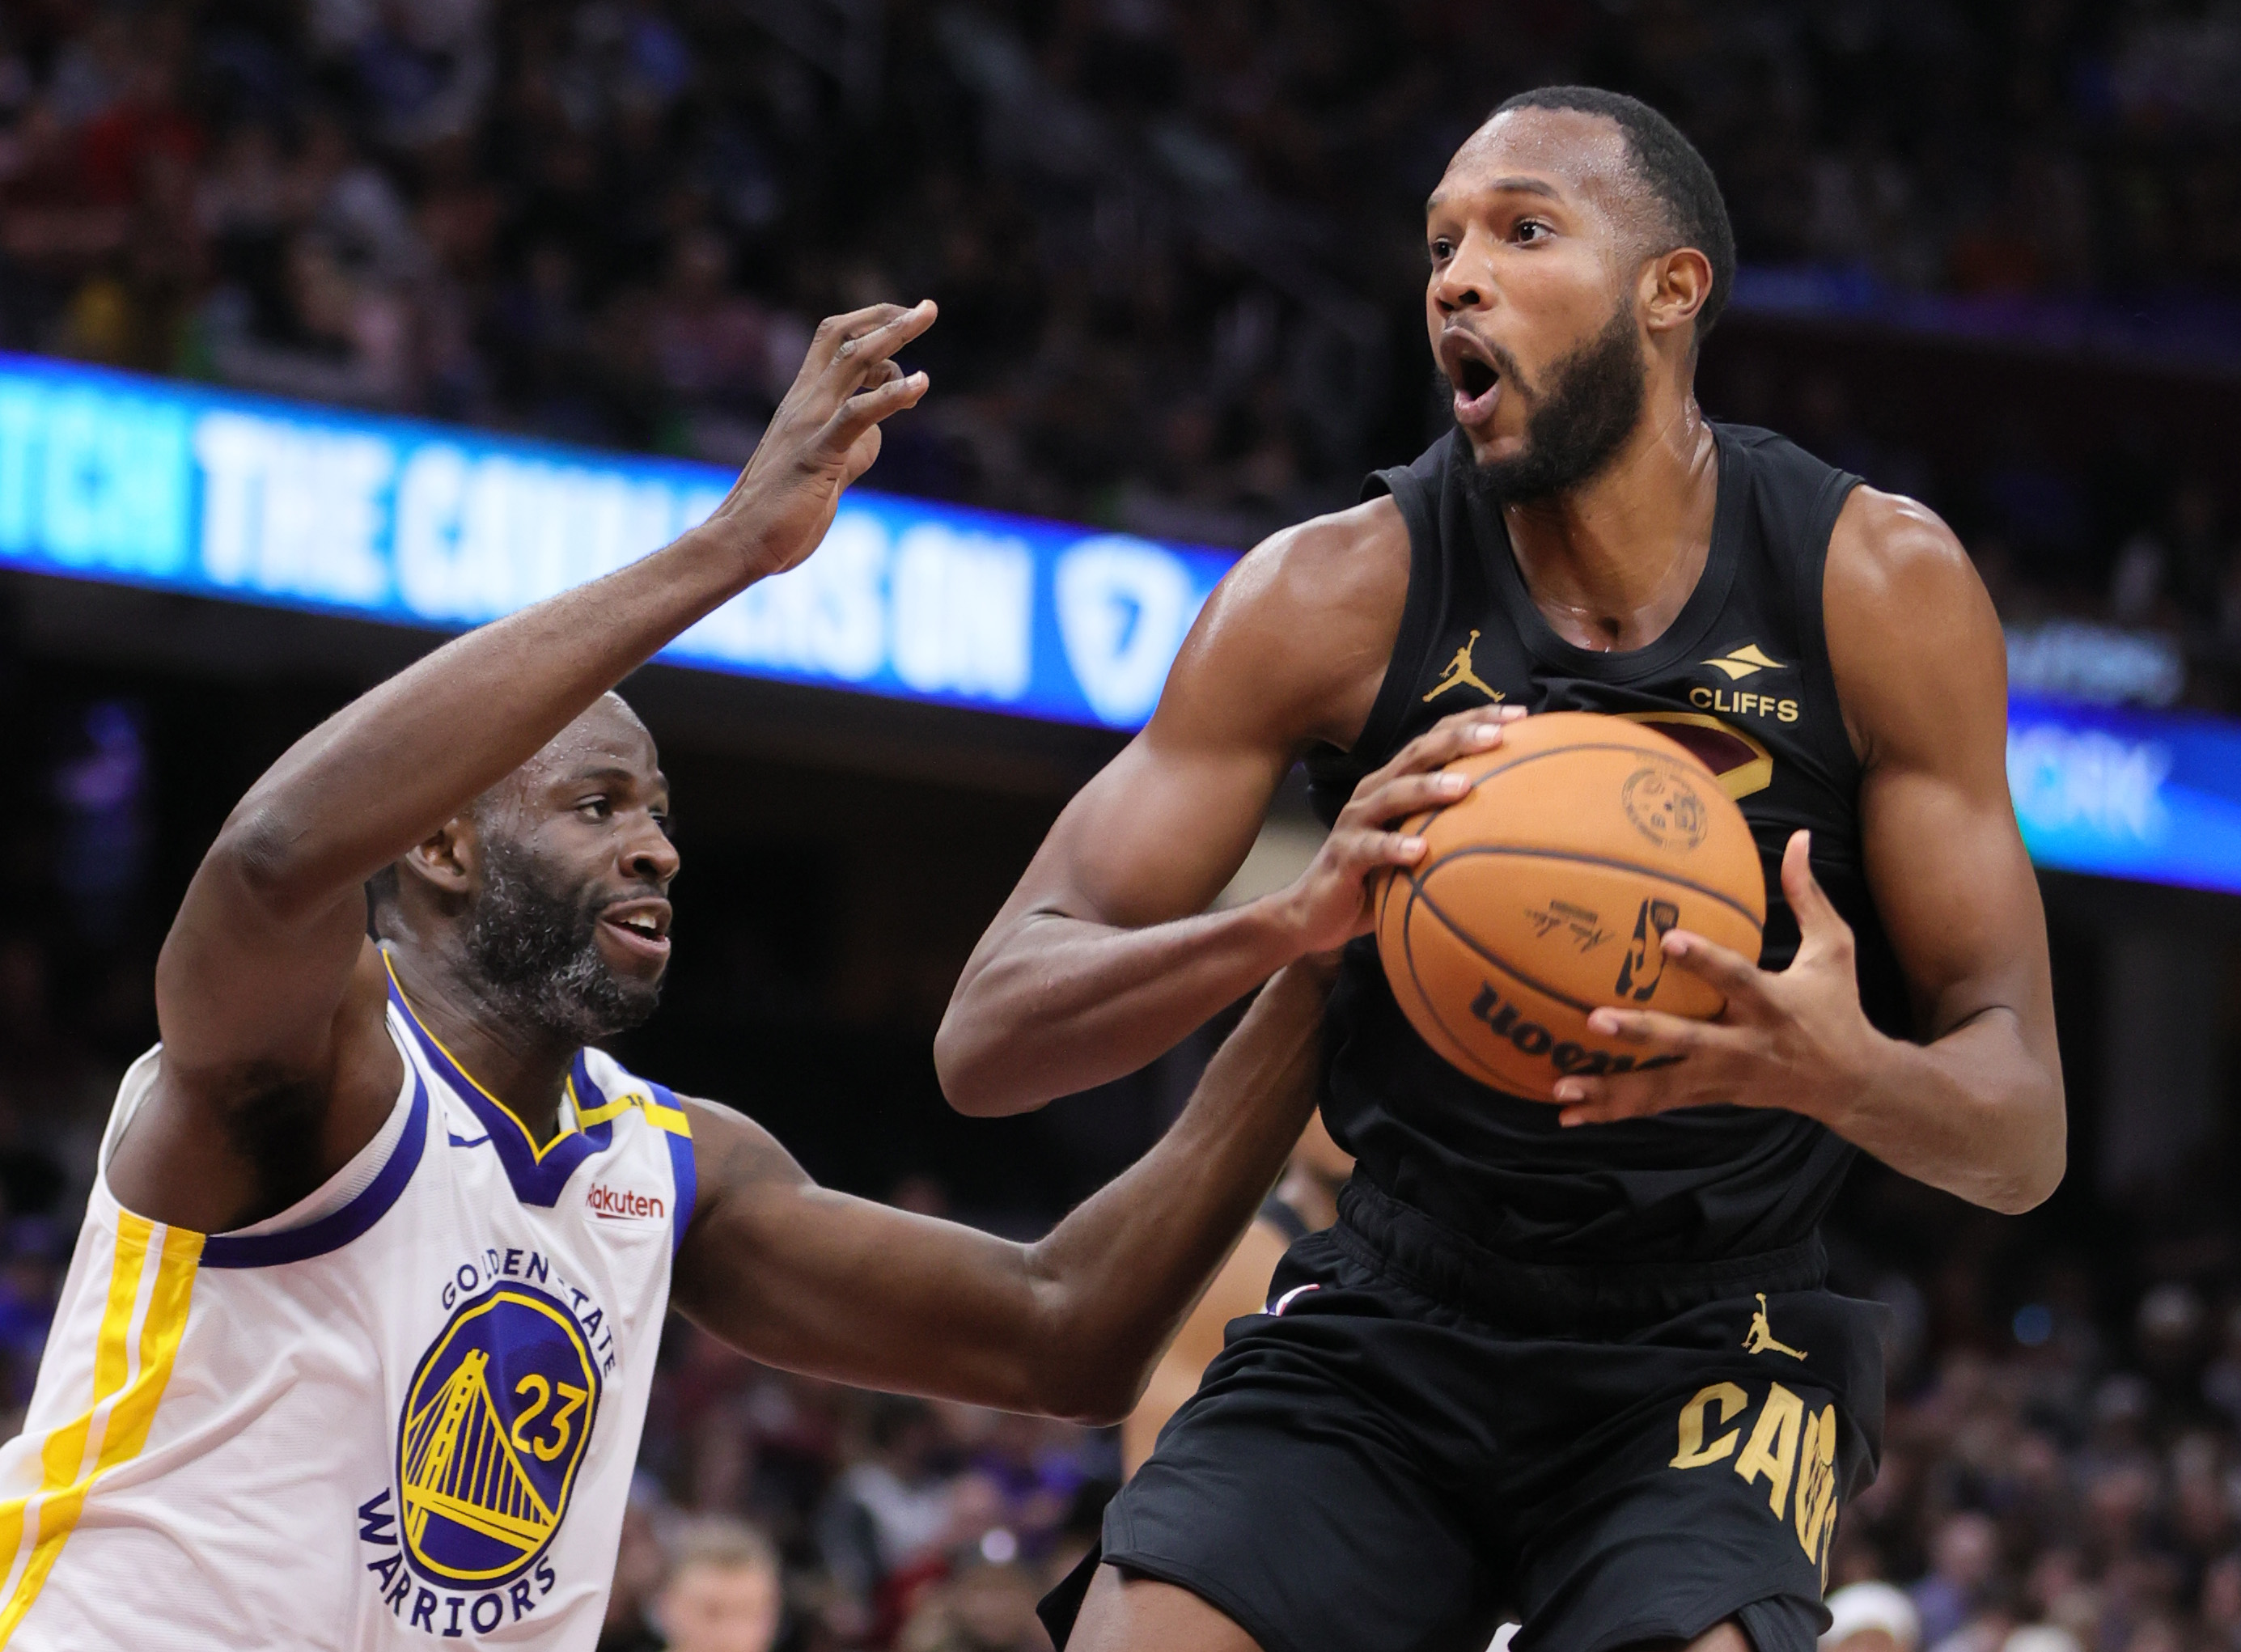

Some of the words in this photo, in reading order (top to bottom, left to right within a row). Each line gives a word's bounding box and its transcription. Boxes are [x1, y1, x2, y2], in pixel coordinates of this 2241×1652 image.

[195, 411, 394, 608] THE
[891, 523, 1033, 702] ON
[1689, 687, 1798, 722] CLIFFS
[442, 1247, 549, 1311] GOLDEN
[557, 1277, 616, 1379] TATE
[512, 1374, 588, 1462] 23
[358, 1486, 557, 1638] WARRIORS
